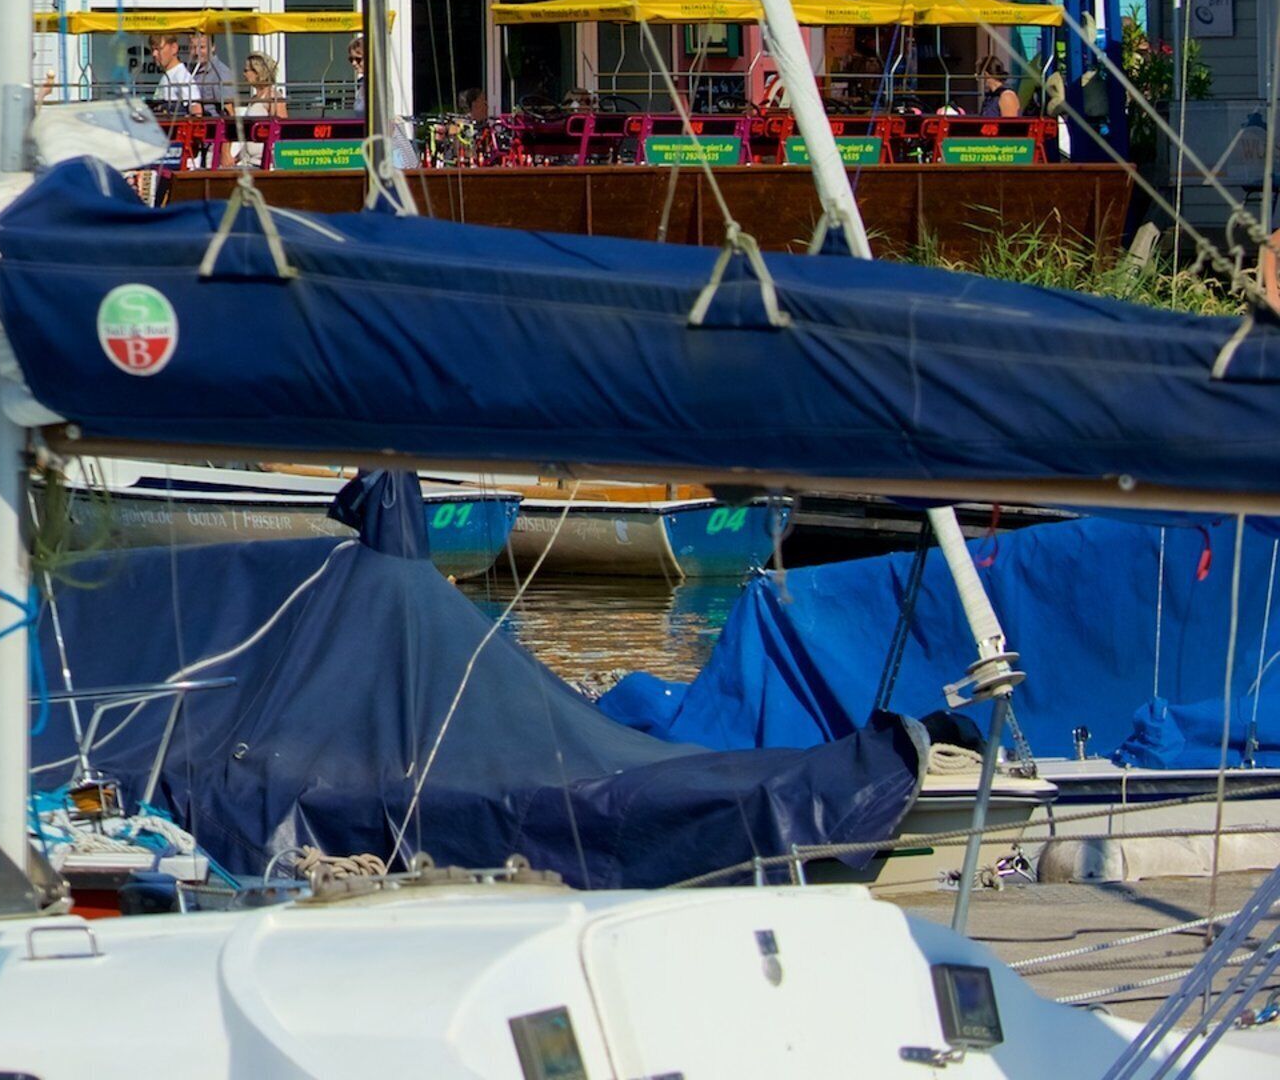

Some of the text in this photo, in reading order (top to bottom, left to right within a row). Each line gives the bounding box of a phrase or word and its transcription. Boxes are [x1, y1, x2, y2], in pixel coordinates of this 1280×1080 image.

[126, 340, 153, 368] B
[432, 502, 474, 530] 01
[516, 515, 559, 532] RISEUR
[706, 506, 749, 535] 04
